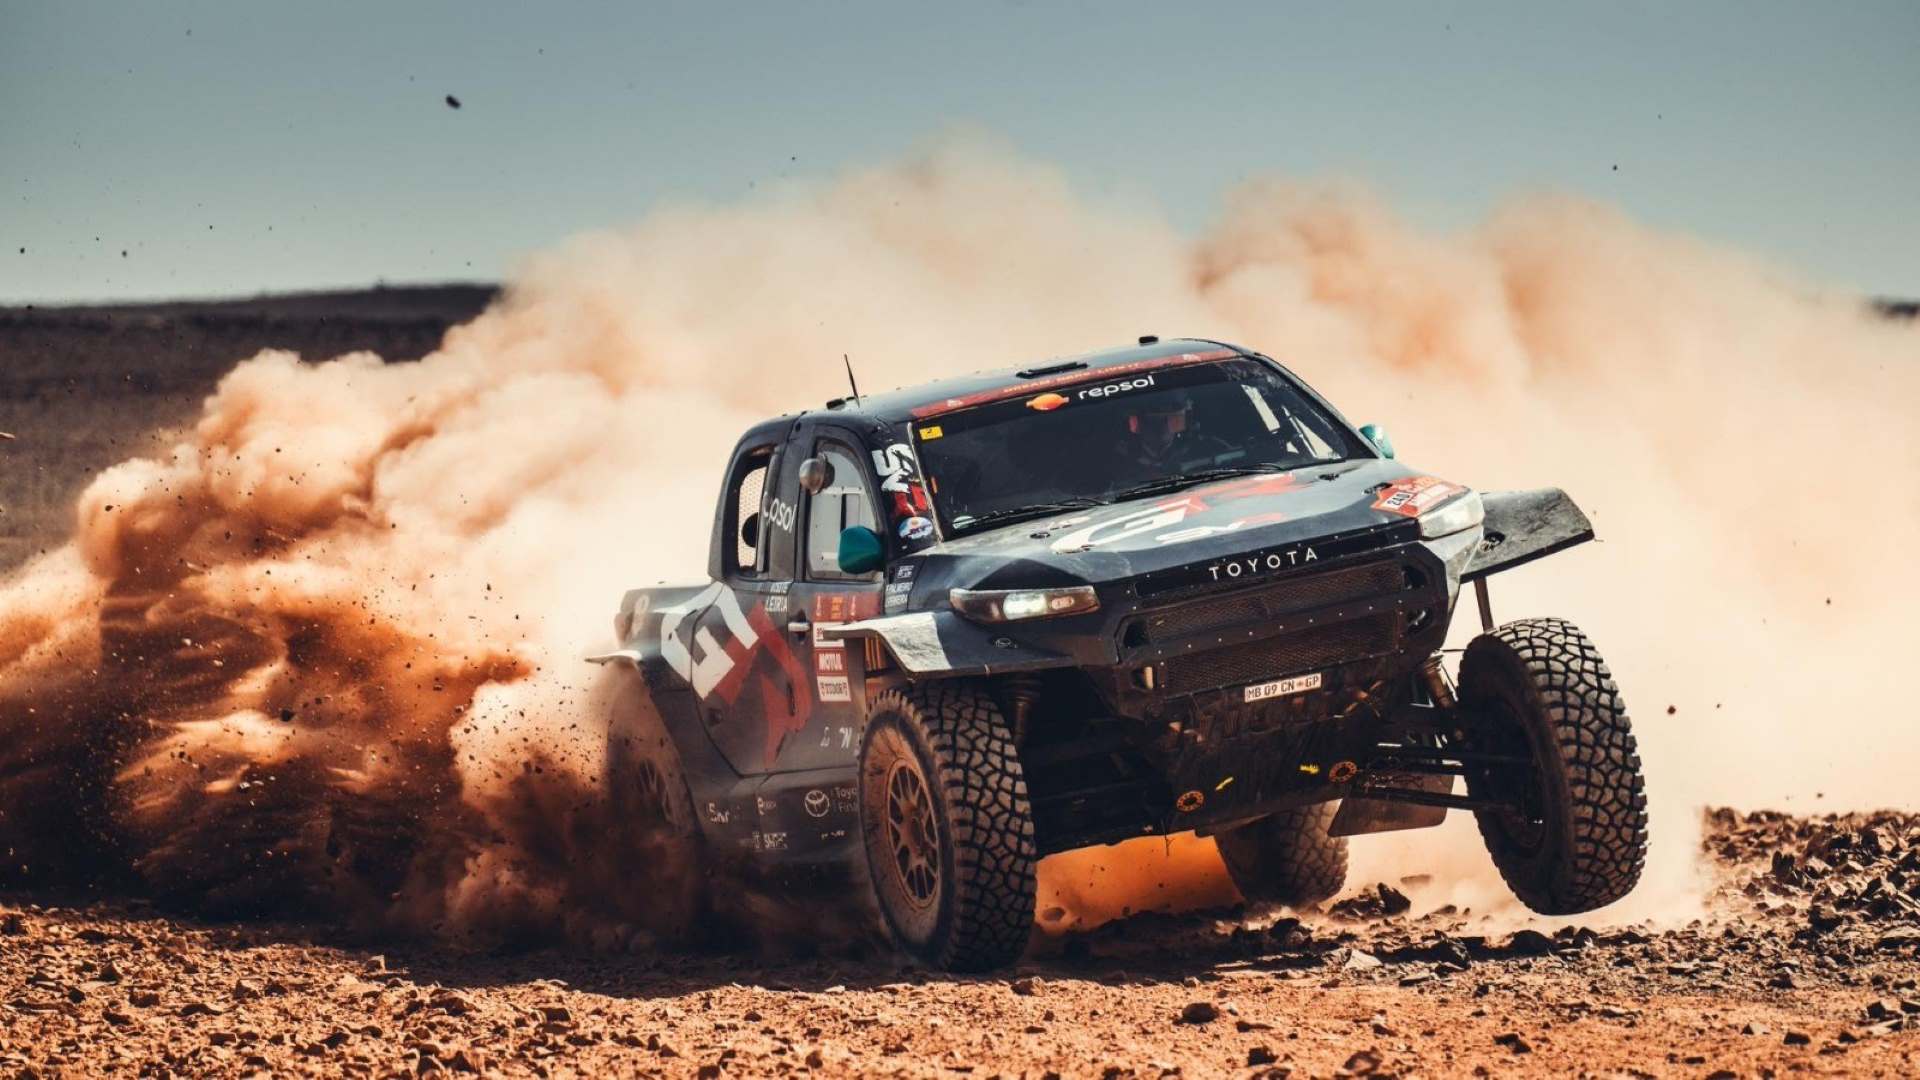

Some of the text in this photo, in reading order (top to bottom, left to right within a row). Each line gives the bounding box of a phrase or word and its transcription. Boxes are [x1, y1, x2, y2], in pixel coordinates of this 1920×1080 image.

[1078, 375, 1155, 400] repsol
[1208, 547, 1318, 580] TOYOTA
[1280, 680, 1295, 693] CN
[1305, 675, 1319, 688] GP
